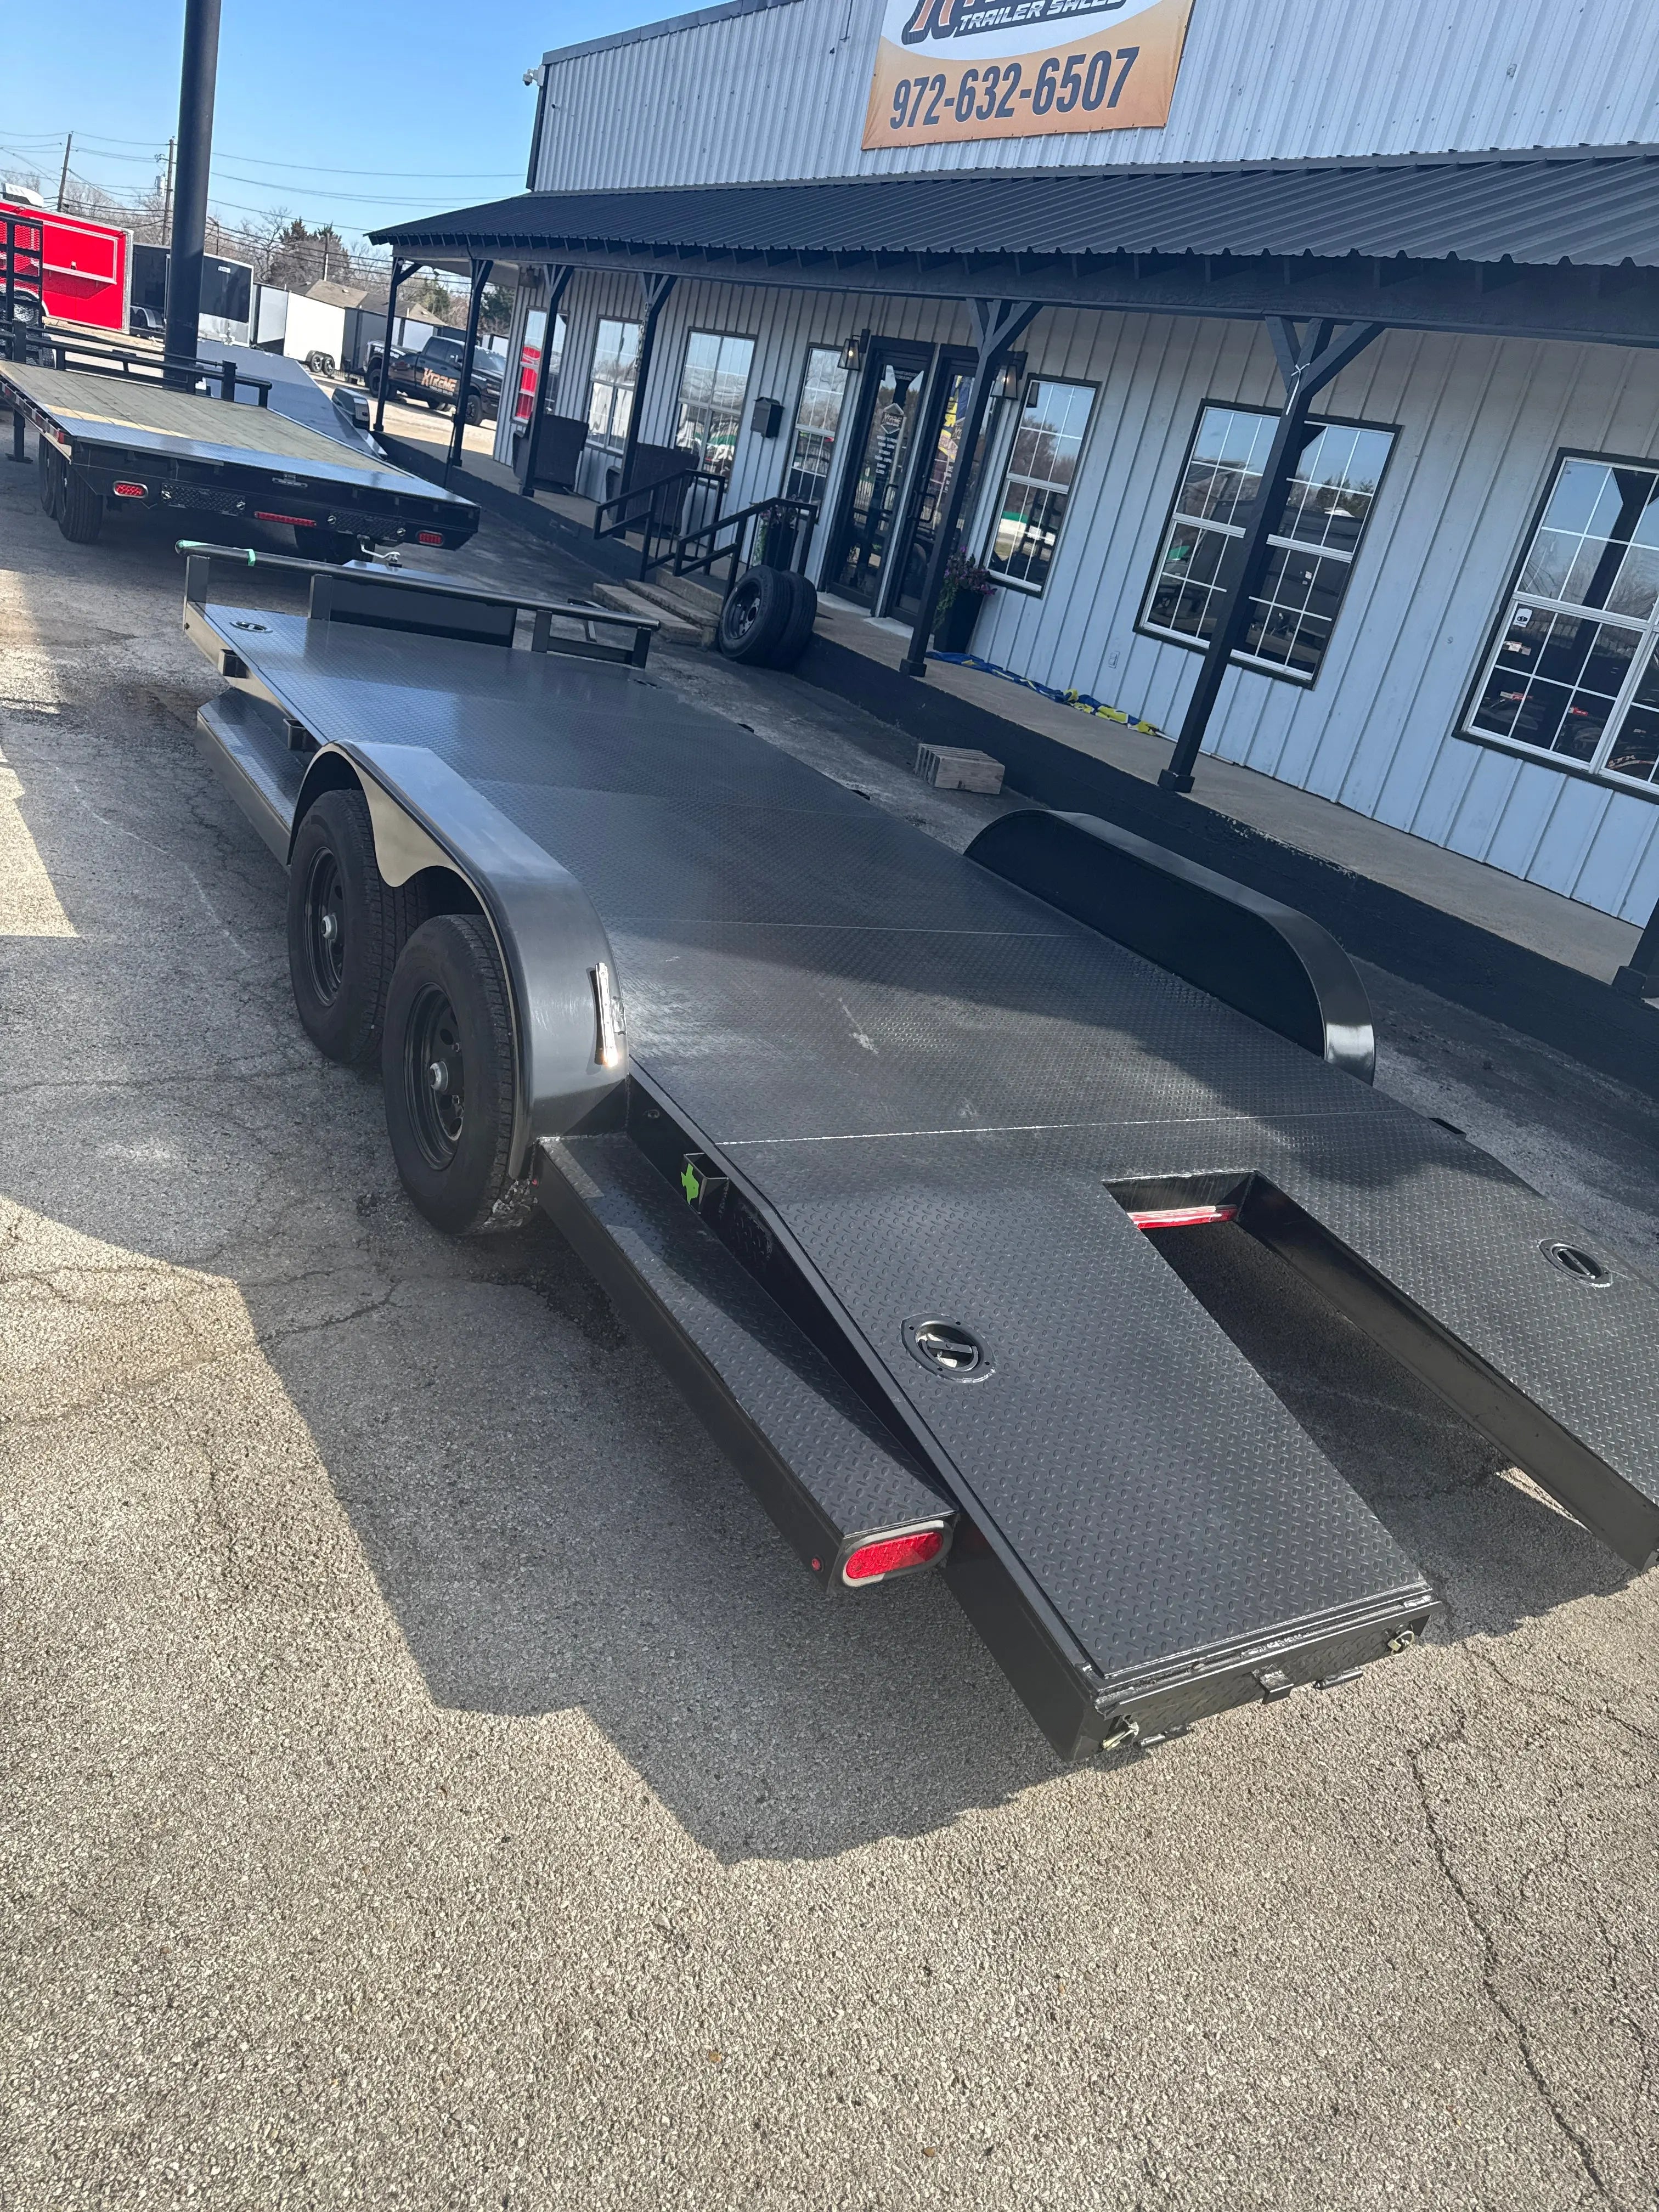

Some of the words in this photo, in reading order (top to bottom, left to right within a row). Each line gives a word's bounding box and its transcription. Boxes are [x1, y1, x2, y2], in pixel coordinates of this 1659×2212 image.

[960, 1, 1045, 31] TRAILER
[1046, 0, 1121, 15] SAL
[890, 46, 1140, 129] 972-632-6507
